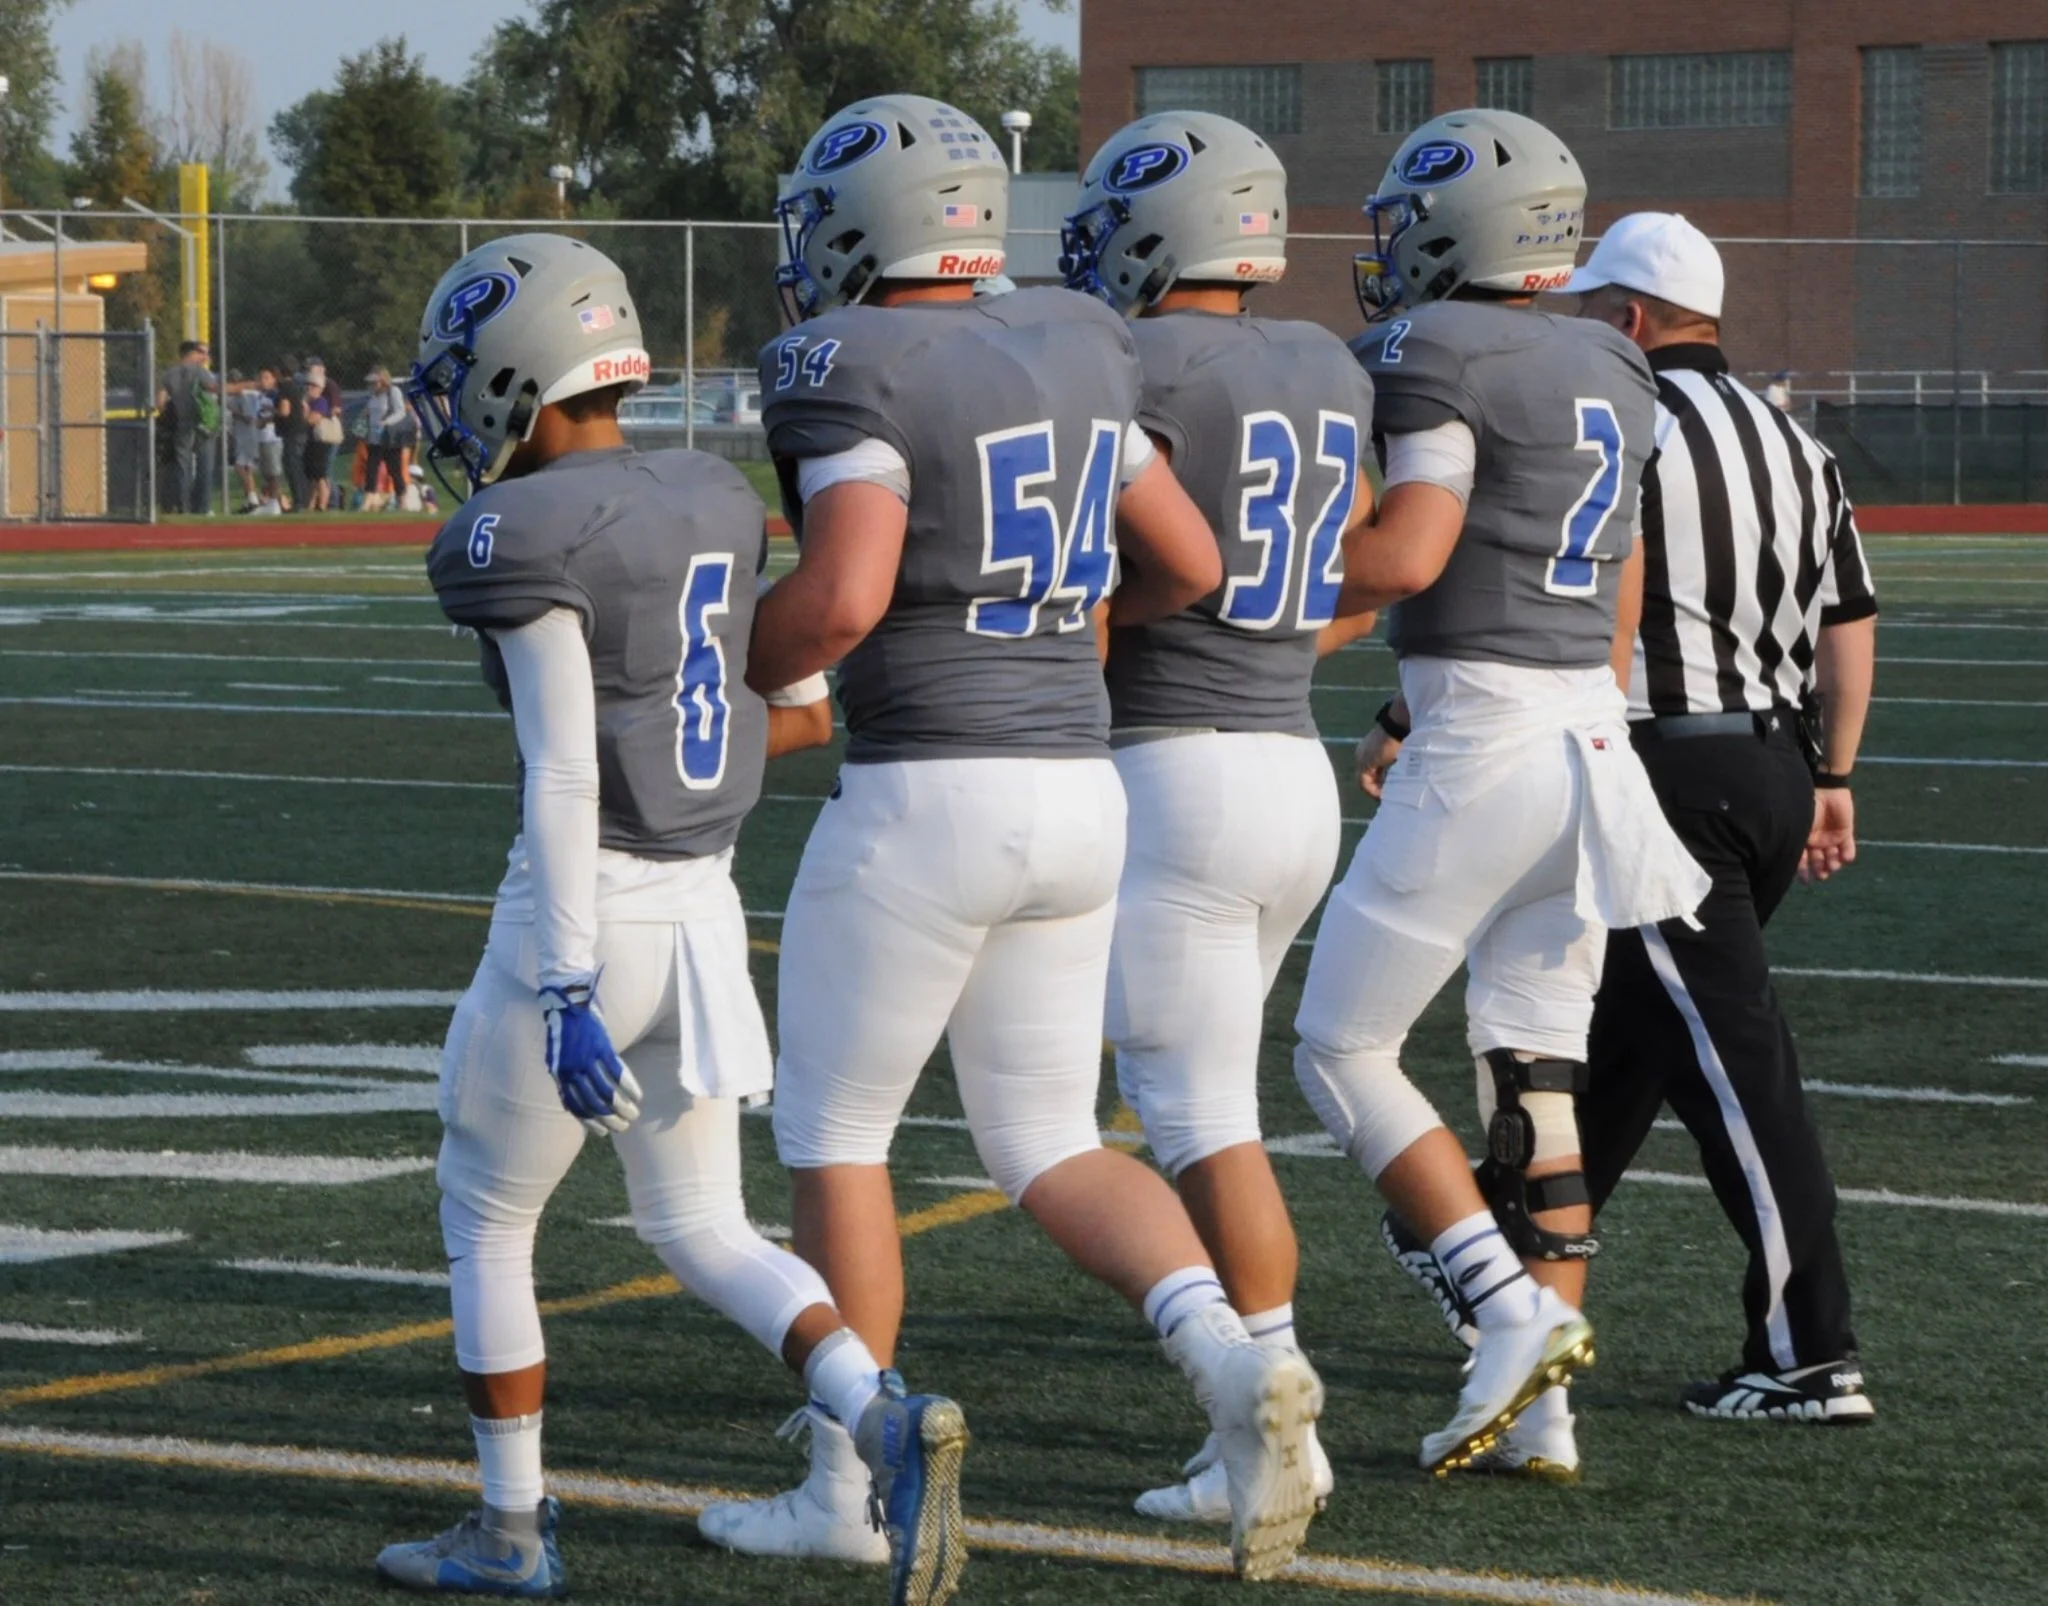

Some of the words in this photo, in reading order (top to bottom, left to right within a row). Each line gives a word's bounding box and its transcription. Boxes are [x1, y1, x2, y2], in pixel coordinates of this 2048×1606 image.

[817, 125, 868, 169] P
[1116, 147, 1169, 188] P
[1407, 146, 1457, 177] P
[447, 277, 493, 331] P
[775, 336, 842, 392] 54
[1382, 320, 1412, 363] 2
[1218, 410, 1358, 631] 32
[1545, 398, 1625, 598] 2
[468, 513, 501, 568] 6
[965, 418, 1122, 639] 54
[671, 552, 735, 791] 6
